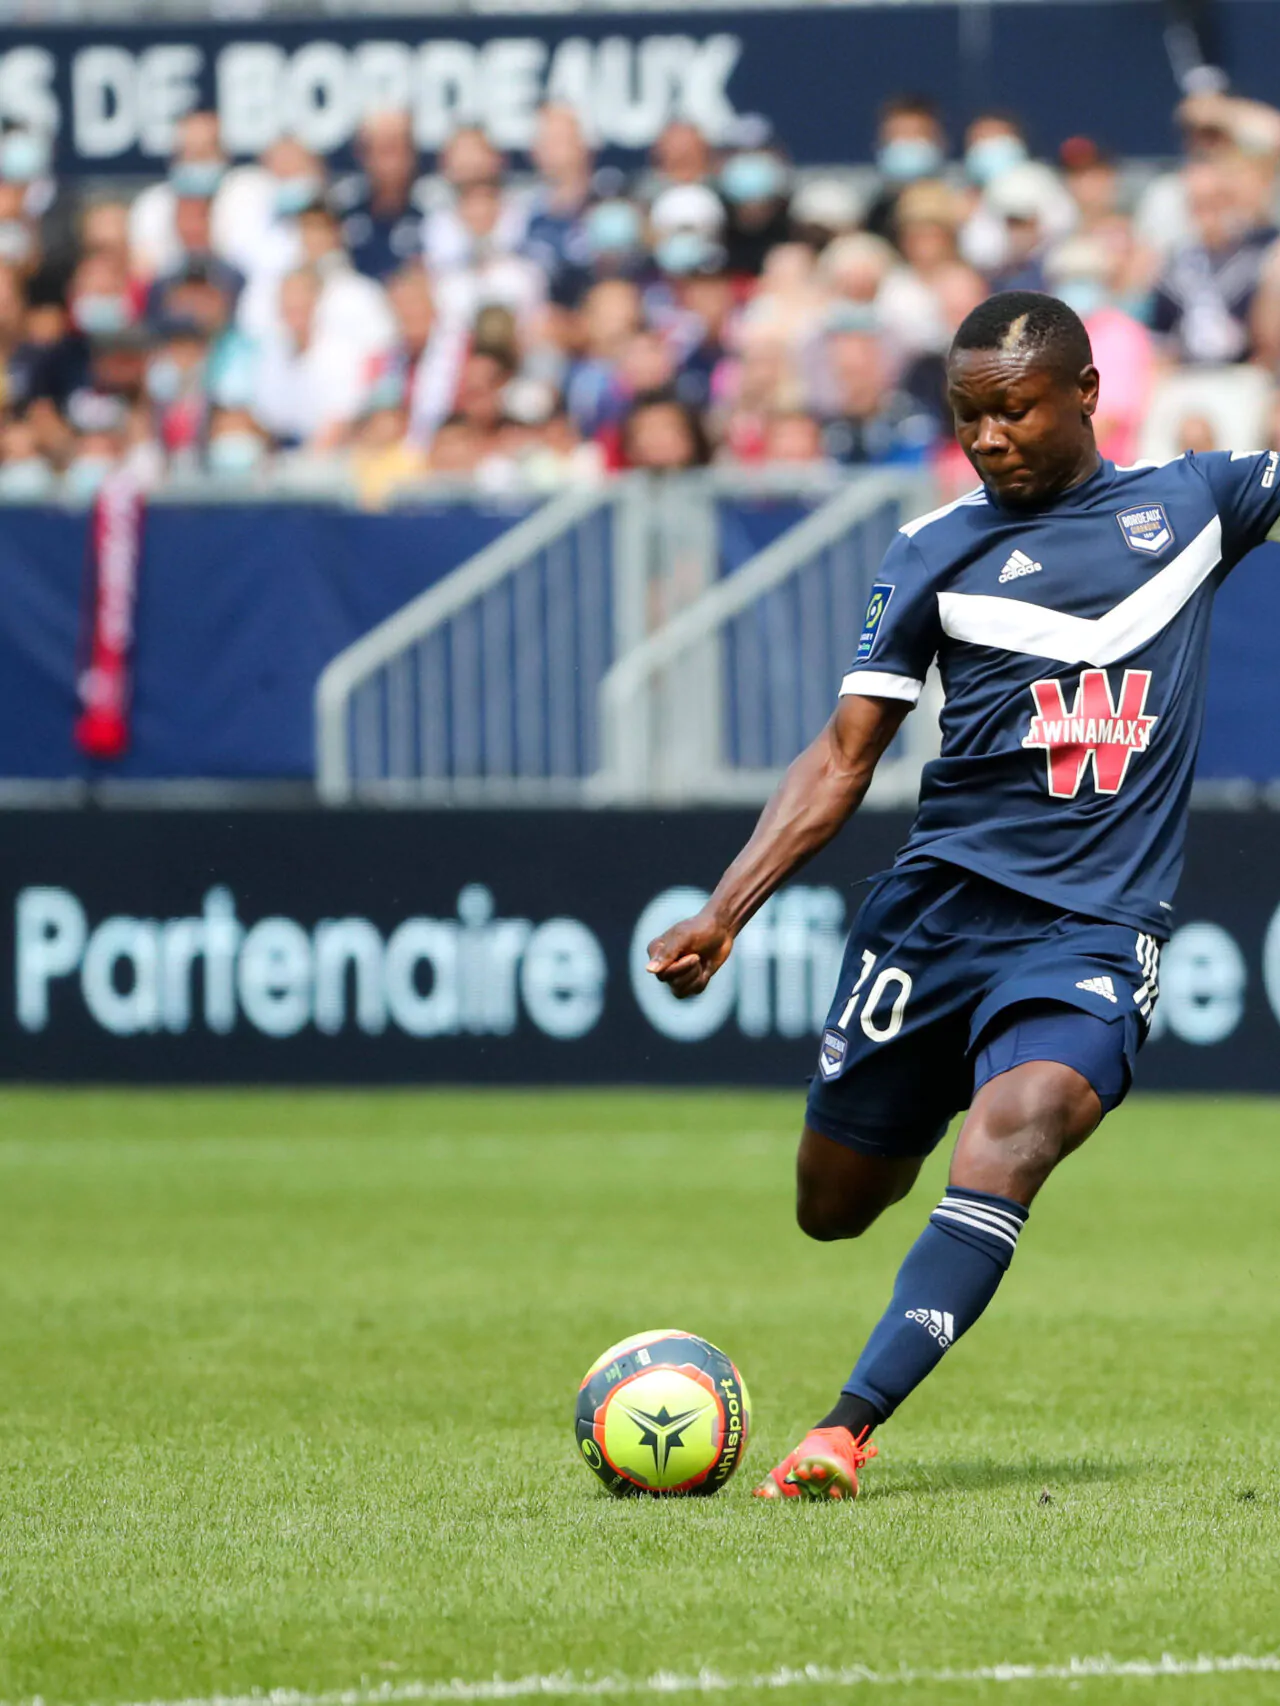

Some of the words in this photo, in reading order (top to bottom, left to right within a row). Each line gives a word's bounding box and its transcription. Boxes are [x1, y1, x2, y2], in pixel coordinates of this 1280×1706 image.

[71, 44, 203, 157] DE
[215, 34, 742, 155] BORDEAUX
[998, 562, 1043, 584] adidas
[1042, 717, 1138, 746] WINAMAX
[15, 884, 604, 1039] Partenaire
[629, 885, 846, 1042] Offi
[1150, 920, 1247, 1046] e
[837, 949, 912, 1042] 10
[715, 1377, 743, 1481] uhlsport
